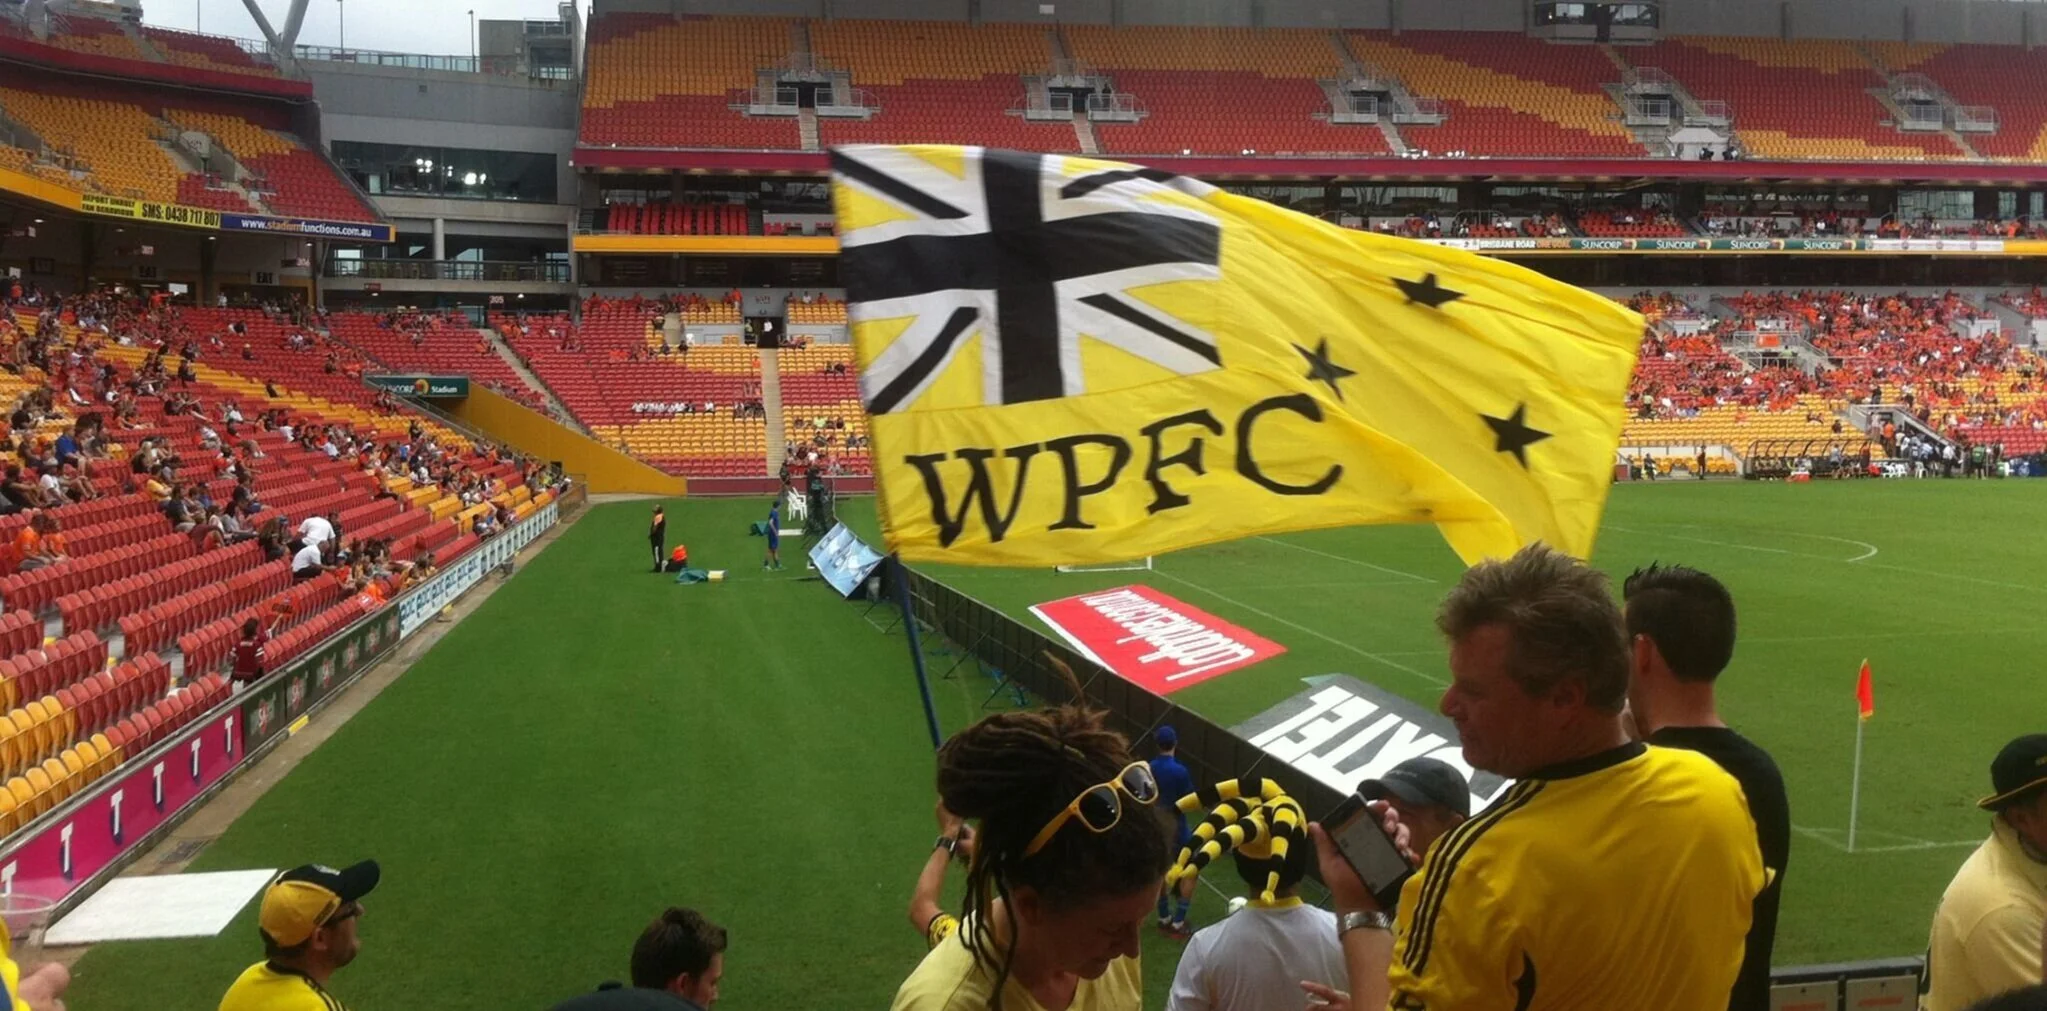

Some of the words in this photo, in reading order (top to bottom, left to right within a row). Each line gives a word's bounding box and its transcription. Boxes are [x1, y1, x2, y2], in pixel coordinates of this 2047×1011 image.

[141, 202, 164, 219] SMS:
[165, 205, 188, 223] 0438
[189, 208, 203, 224] 717
[204, 210, 219, 227] 807
[241, 218, 372, 238] www.stadiumfunctions.com.au
[1479, 239, 1515, 249] BRISBANE
[1516, 239, 1536, 249] ROAR
[1580, 239, 1622, 250] SUNCORP
[1656, 239, 1698, 250] SUNCORP
[1730, 239, 1771, 250] SUNCORP
[1803, 239, 1842, 250] SUNCORP
[256, 271, 273, 284] EAT
[431, 385, 458, 394] Stadium
[905, 393, 1343, 548] WPFC
